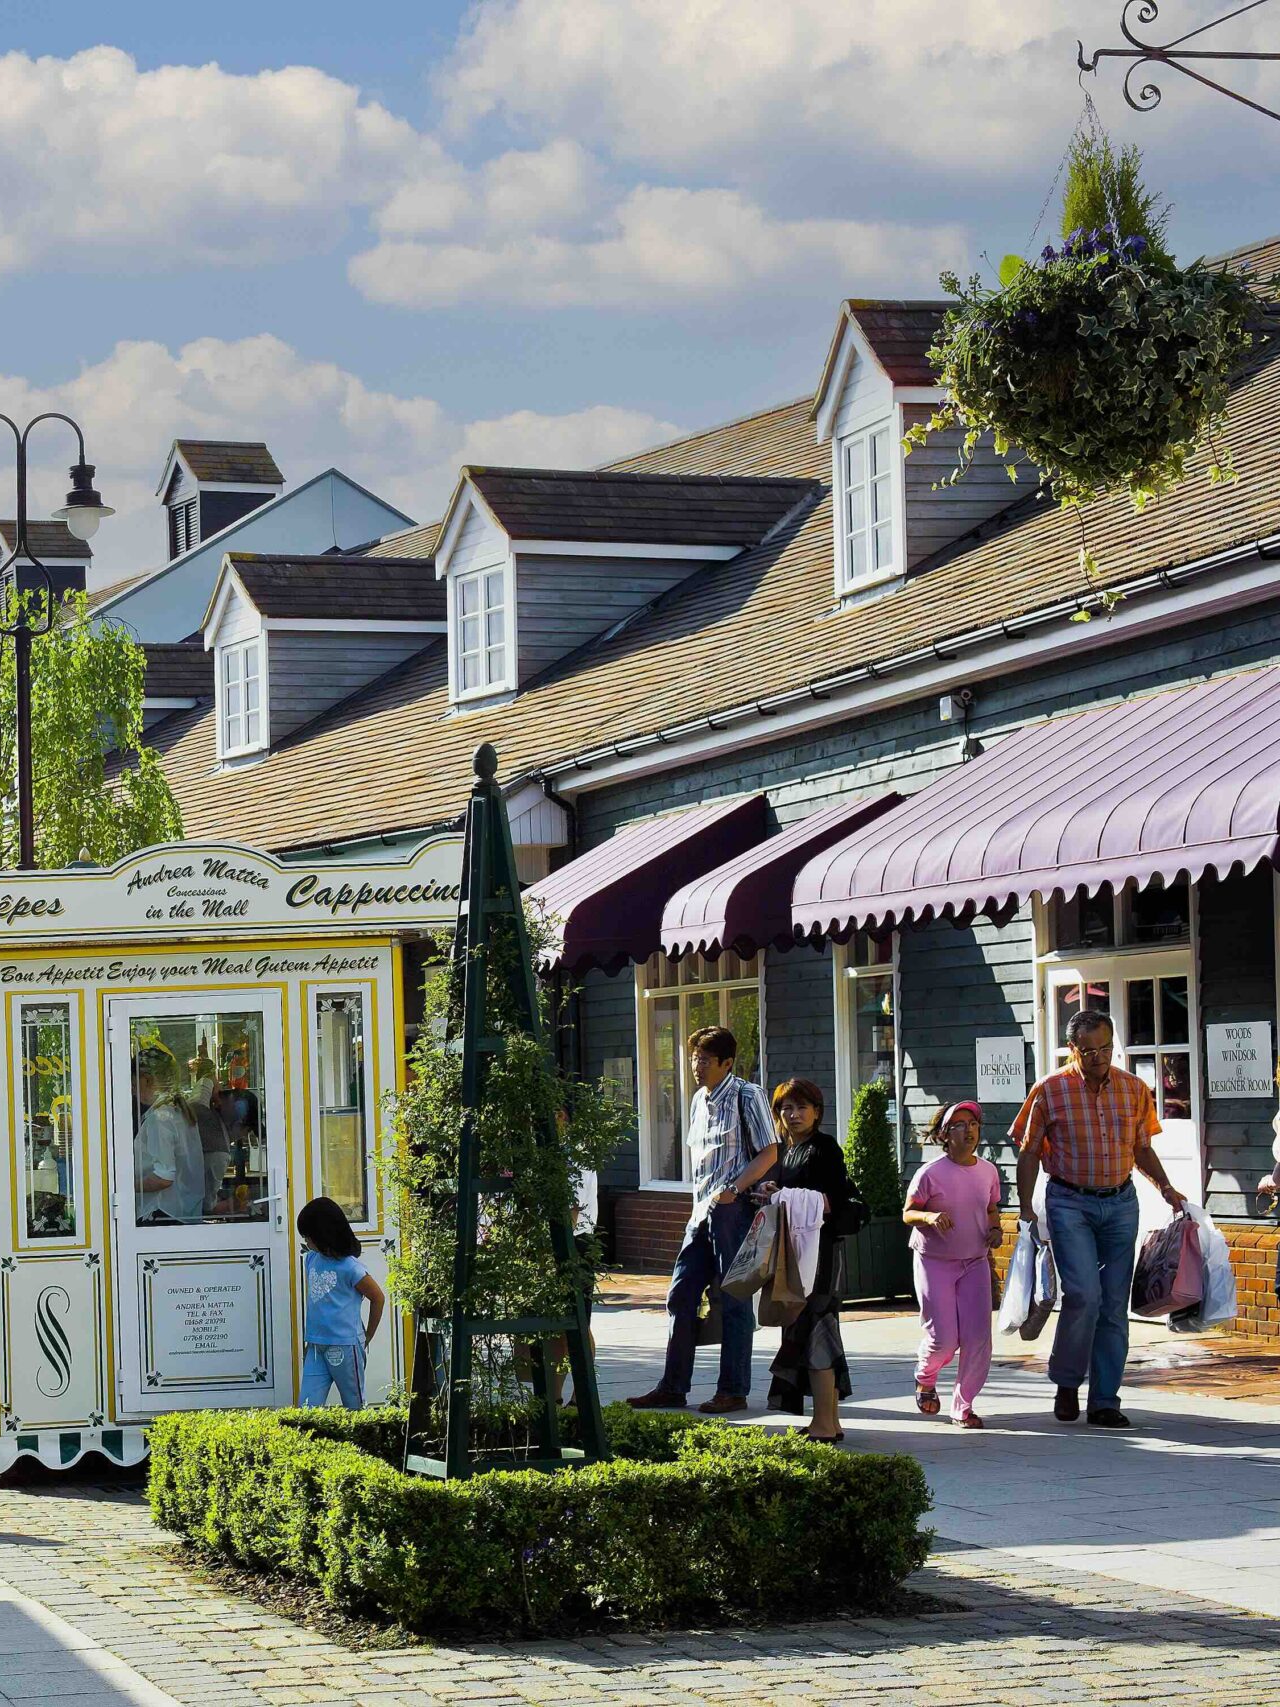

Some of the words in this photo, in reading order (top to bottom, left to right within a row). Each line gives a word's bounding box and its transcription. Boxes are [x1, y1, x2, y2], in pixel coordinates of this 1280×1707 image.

[126, 864, 195, 896] Andrea
[202, 857, 270, 890] Mattia
[167, 885, 227, 898] Concessions
[145, 904, 164, 919] in
[169, 900, 195, 919] the
[202, 898, 249, 919] Mall
[0, 965, 35, 983] Bon
[36, 963, 105, 987] Appetit
[107, 961, 157, 982] Enjoy
[160, 964, 199, 980] your
[202, 957, 251, 976] Meal
[254, 955, 311, 978] Gutem
[312, 953, 380, 975] Appetit
[1225, 1027, 1252, 1040] WOODS
[1235, 1040, 1241, 1048] of
[991, 1053, 1010, 1063] THE
[1222, 1049, 1257, 1061] WINDSOR
[980, 1063, 1022, 1076] DESIGNER
[1235, 1065, 1242, 1077] @
[1211, 1080, 1246, 1092] DESIGNER
[1248, 1079, 1271, 1091] ROOM
[207, 1301, 234, 1309] MATTIA
